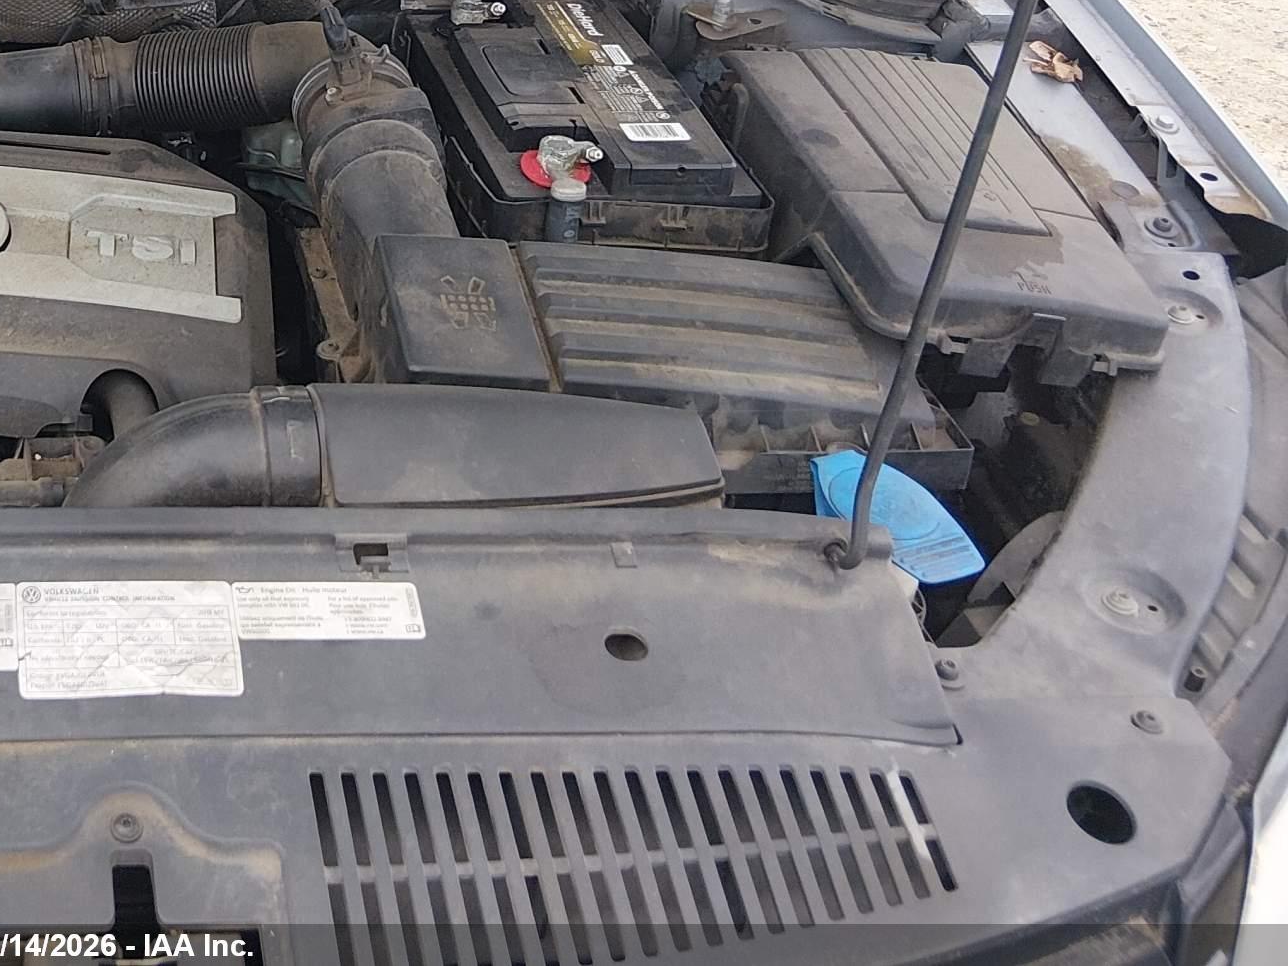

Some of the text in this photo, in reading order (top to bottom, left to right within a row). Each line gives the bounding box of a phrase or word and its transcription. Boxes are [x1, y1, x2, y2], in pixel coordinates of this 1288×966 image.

[567, 3, 604, 37] DieHard
[86, 229, 197, 266] TSI
[43, 586, 99, 595] VOLKSWAGEN
